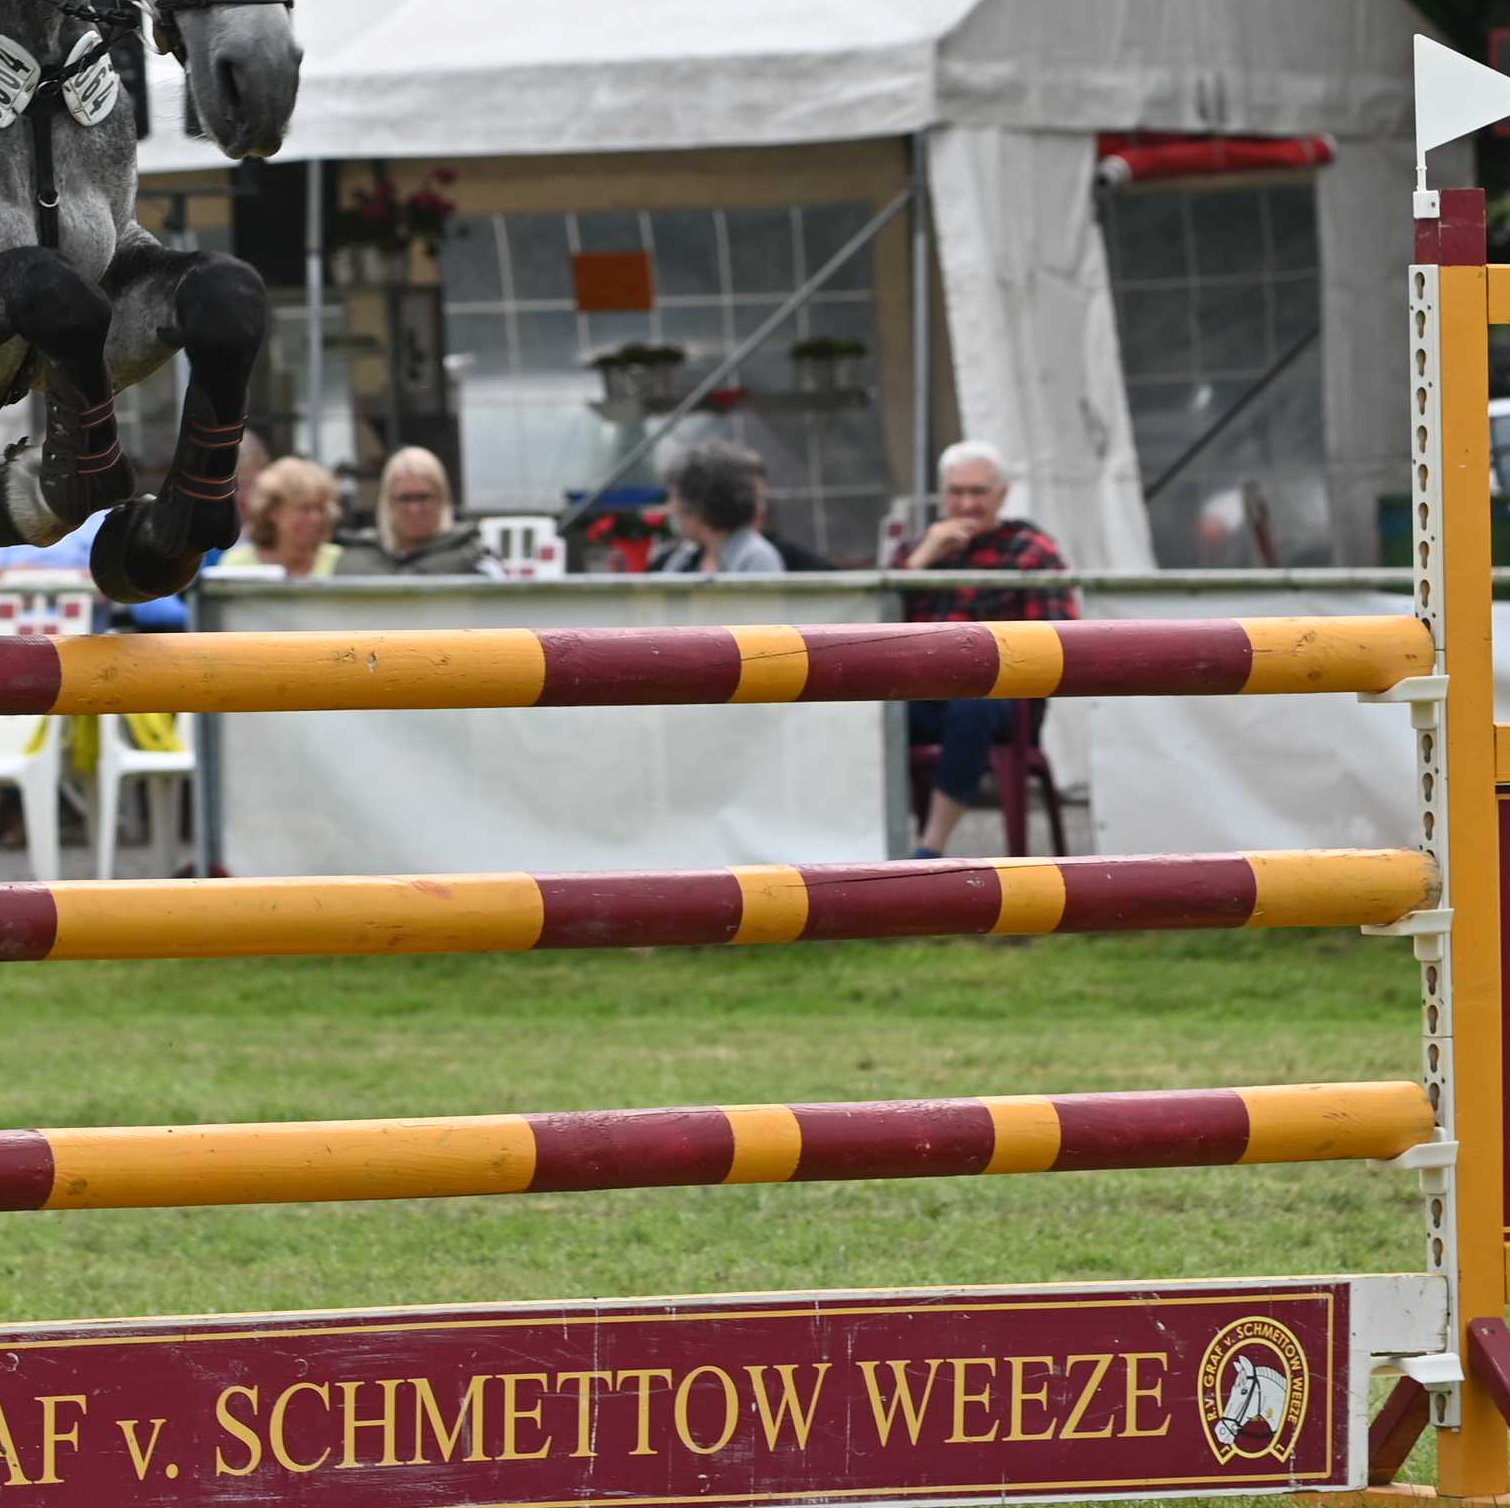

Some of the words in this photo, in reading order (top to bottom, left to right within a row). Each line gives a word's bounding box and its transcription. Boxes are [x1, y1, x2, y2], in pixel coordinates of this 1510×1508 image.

[1224, 1337, 1235, 1347] v.
[1236, 1323, 1303, 1371] SCHMETTOW
[1204, 1345, 1224, 1388] GRAF
[116, 1416, 178, 1483] v.
[213, 1361, 830, 1478] SCHMETTOW
[856, 1351, 1172, 1449] WEEZE
[1204, 1392, 1217, 1421] R.V.
[1287, 1376, 1304, 1423] WEEZE
